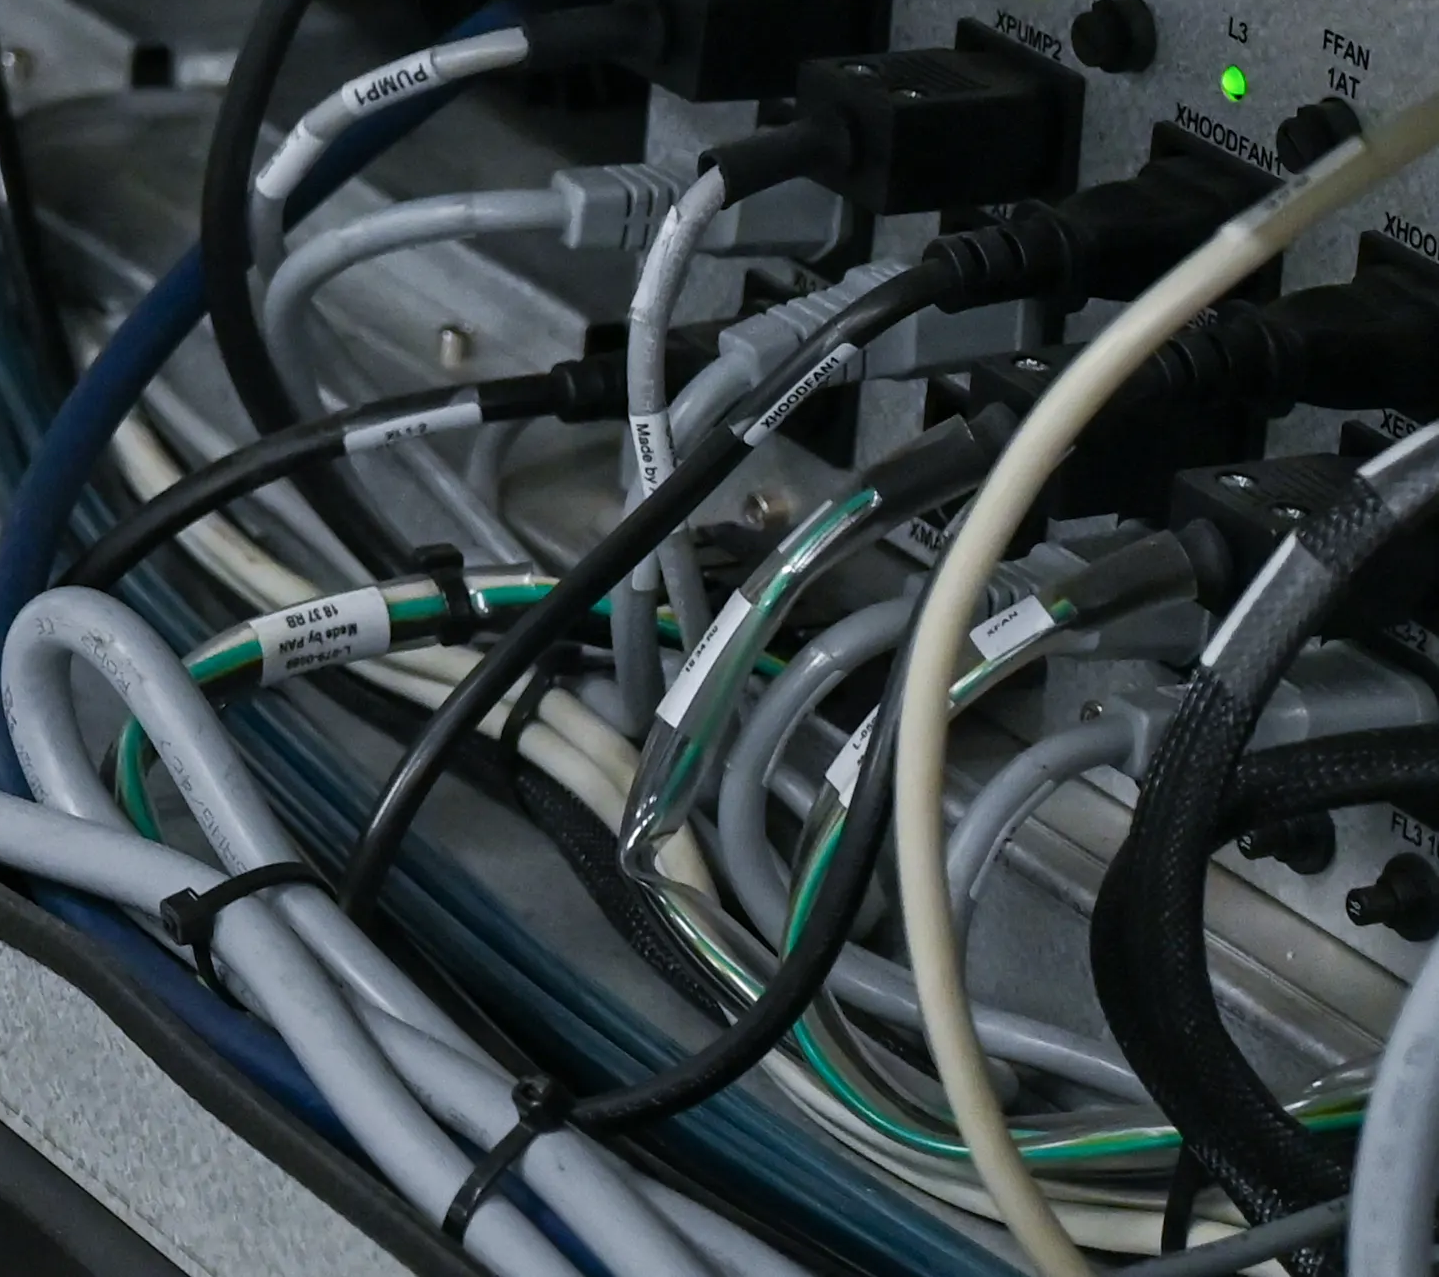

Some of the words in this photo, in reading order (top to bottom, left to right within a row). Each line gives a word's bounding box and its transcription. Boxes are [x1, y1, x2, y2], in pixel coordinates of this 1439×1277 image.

[995, 10, 1062, 61] XPUMP2
[1228, 16, 1248, 44] L3
[1322, 29, 1370, 70] FFAN
[354, 63, 429, 107] PUMP1
[1327, 67, 1360, 100] 1AT
[1174, 102, 1283, 176] XHOODFAN1
[1384, 211, 1439, 262] XHOO
[761, 356, 840, 429] XHOODFAN1
[308, 629, 324, 645] by
[325, 623, 358, 641] Made
[1391, 810, 1423, 847] FL3
